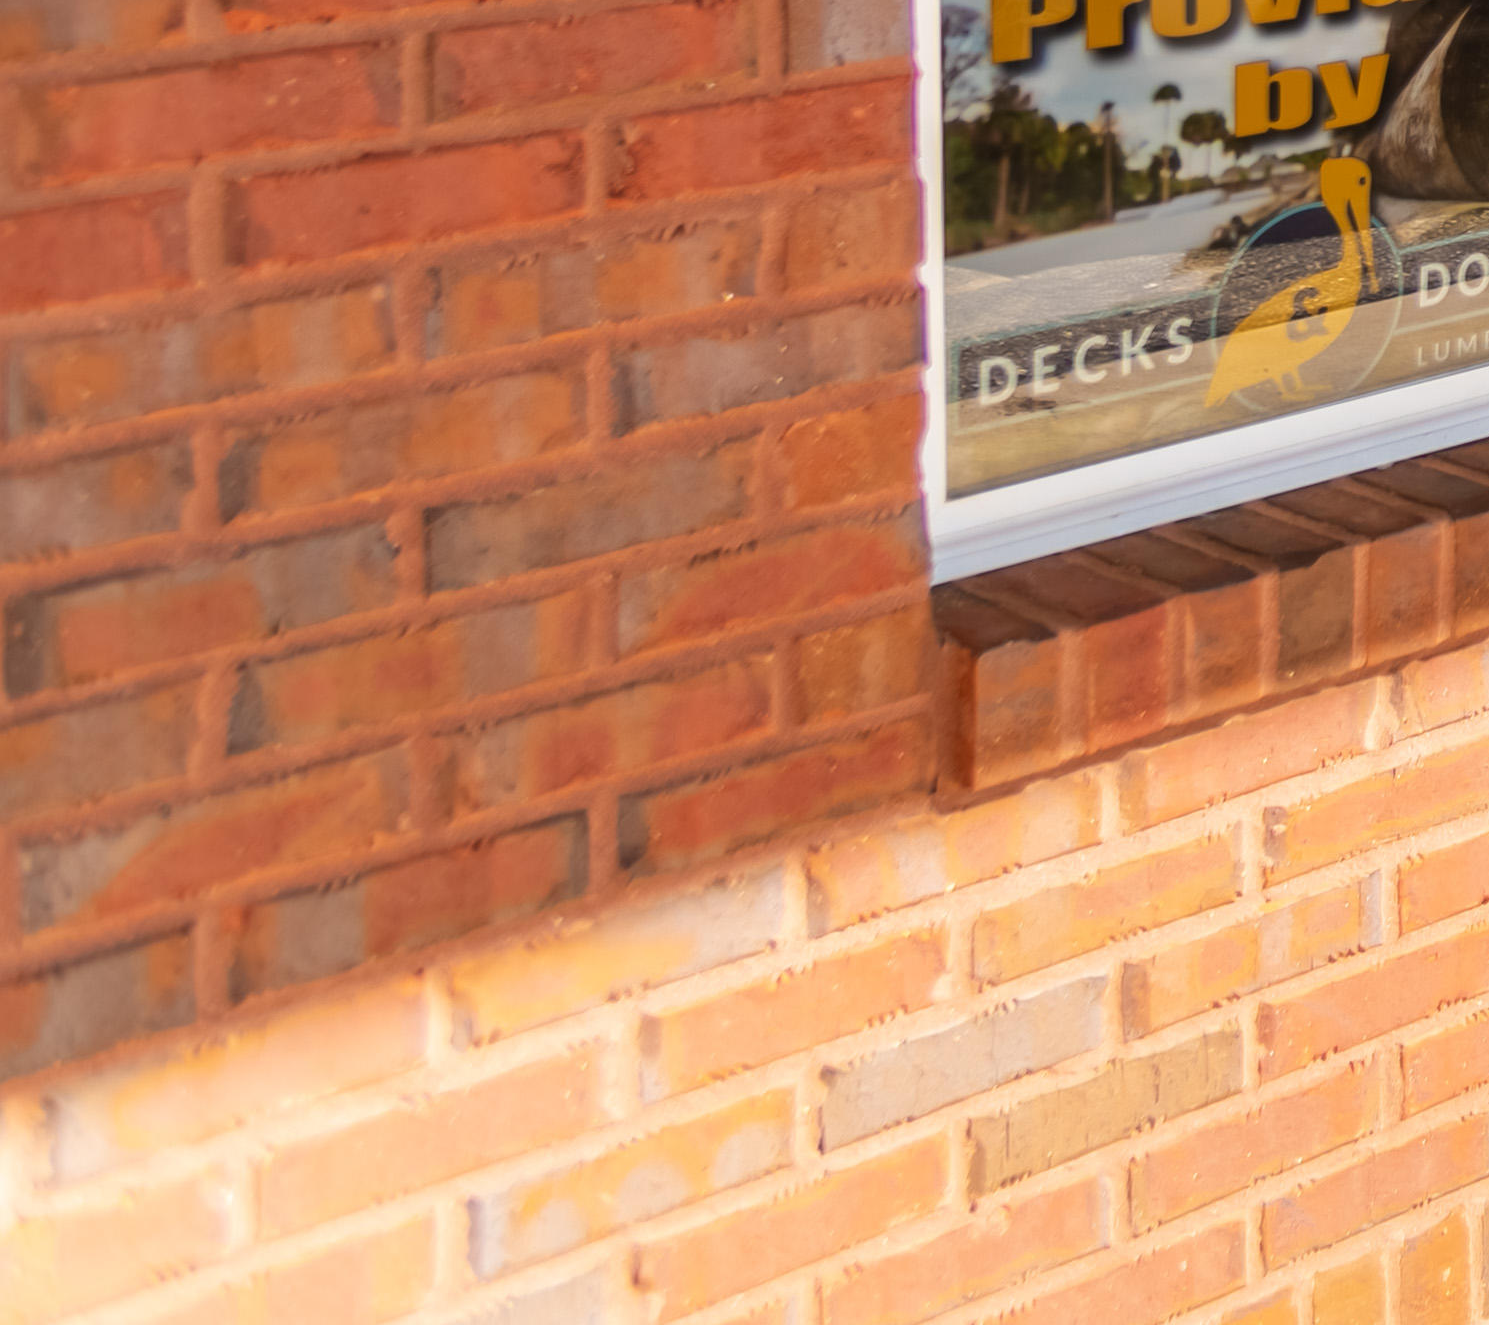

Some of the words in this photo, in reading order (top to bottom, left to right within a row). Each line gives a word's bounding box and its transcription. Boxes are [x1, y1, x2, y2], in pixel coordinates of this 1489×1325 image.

[1234, 52, 1390, 138] by
[977, 316, 1195, 408] DECKS
[1286, 286, 1330, 342] &
